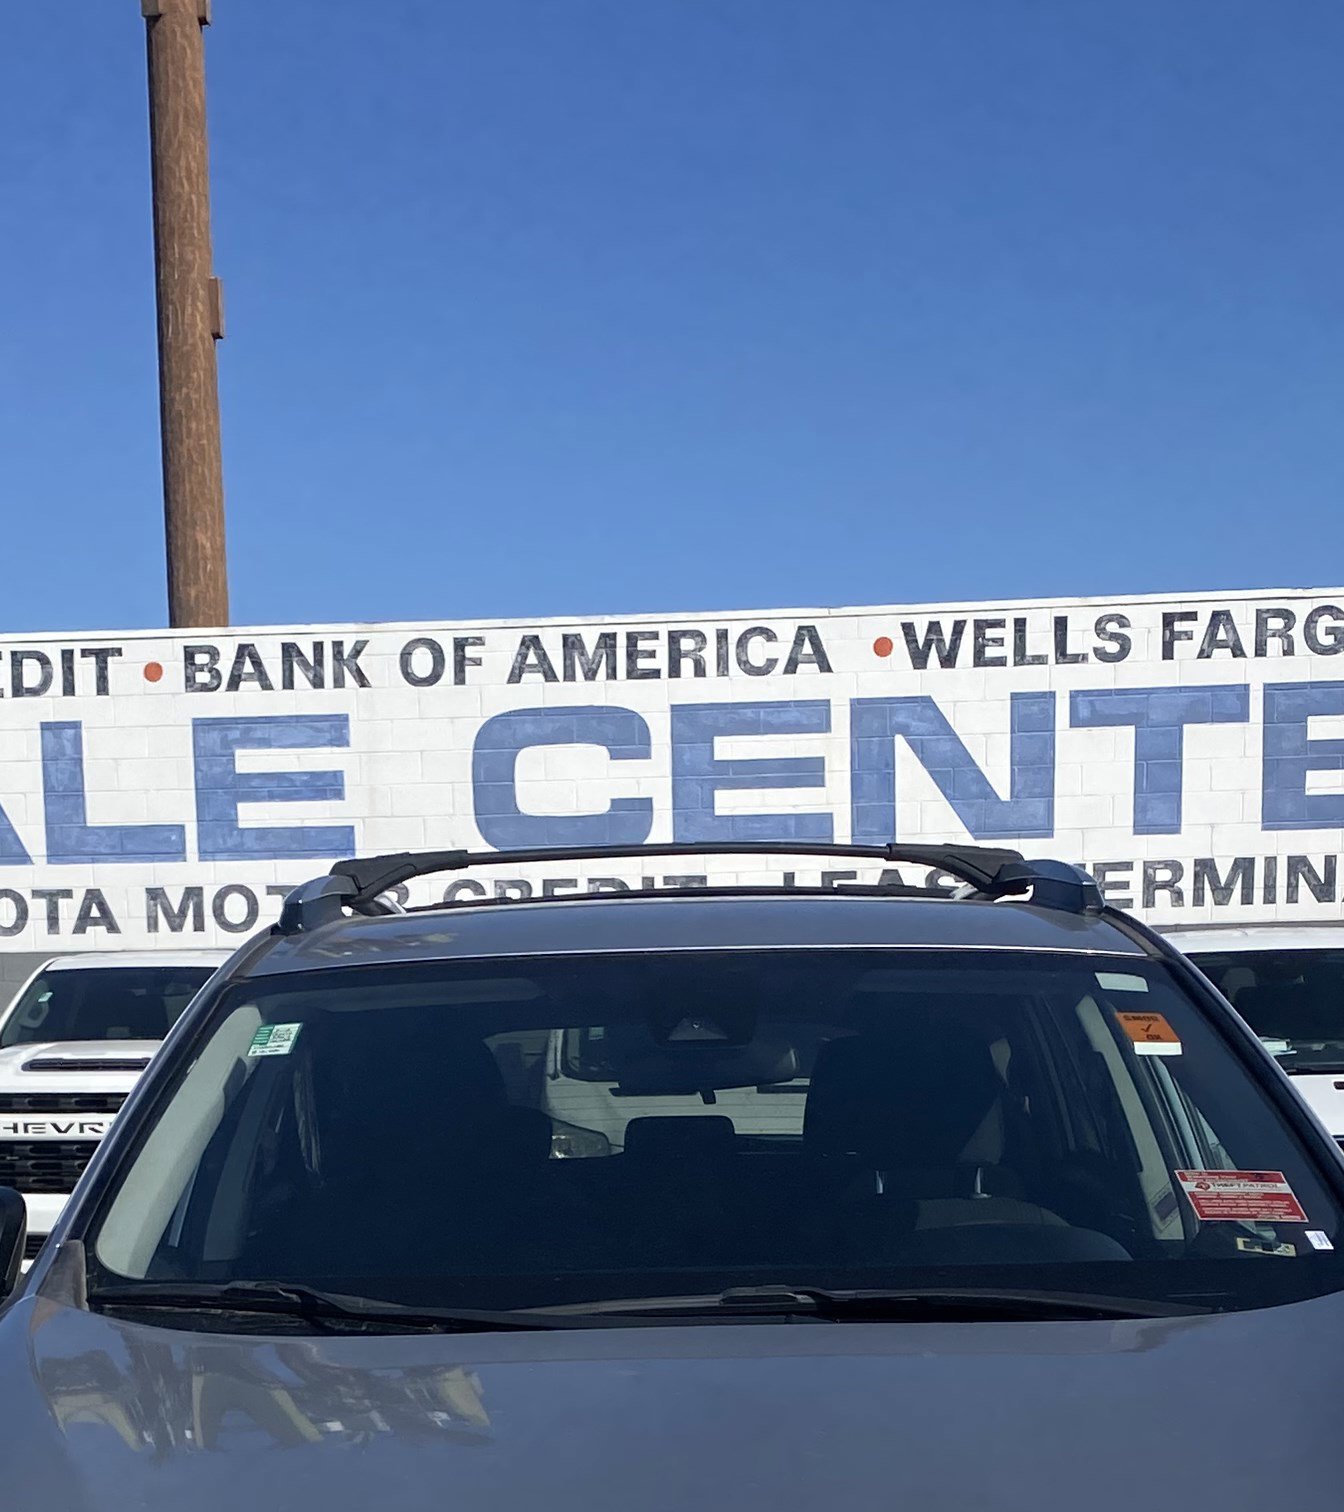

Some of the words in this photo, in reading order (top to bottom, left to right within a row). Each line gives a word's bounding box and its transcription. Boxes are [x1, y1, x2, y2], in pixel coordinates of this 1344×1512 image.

[183, 640, 372, 693] BANK
[399, 636, 485, 687] OF
[507, 624, 834, 684] AMERICA
[901, 612, 1132, 670] WELLS
